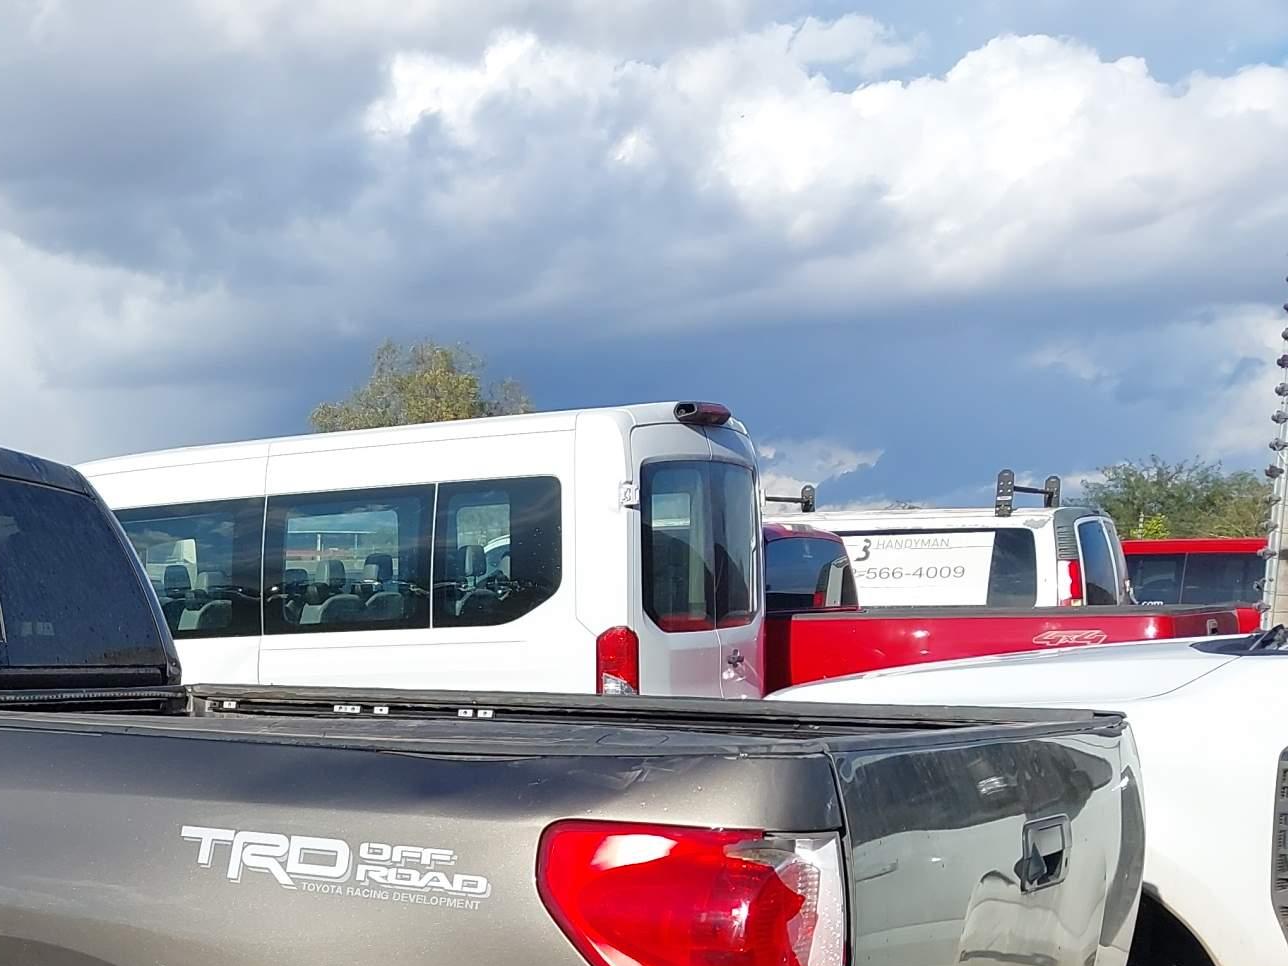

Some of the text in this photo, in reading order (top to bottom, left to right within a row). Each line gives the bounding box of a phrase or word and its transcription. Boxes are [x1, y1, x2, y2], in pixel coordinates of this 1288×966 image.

[875, 538, 951, 550] HANDYMAN
[181, 824, 354, 890] TRD
[359, 842, 458, 868] OFF
[300, 880, 481, 911] TOYOTA RACING DEVELOPMENT
[355, 863, 492, 899] ROAD
